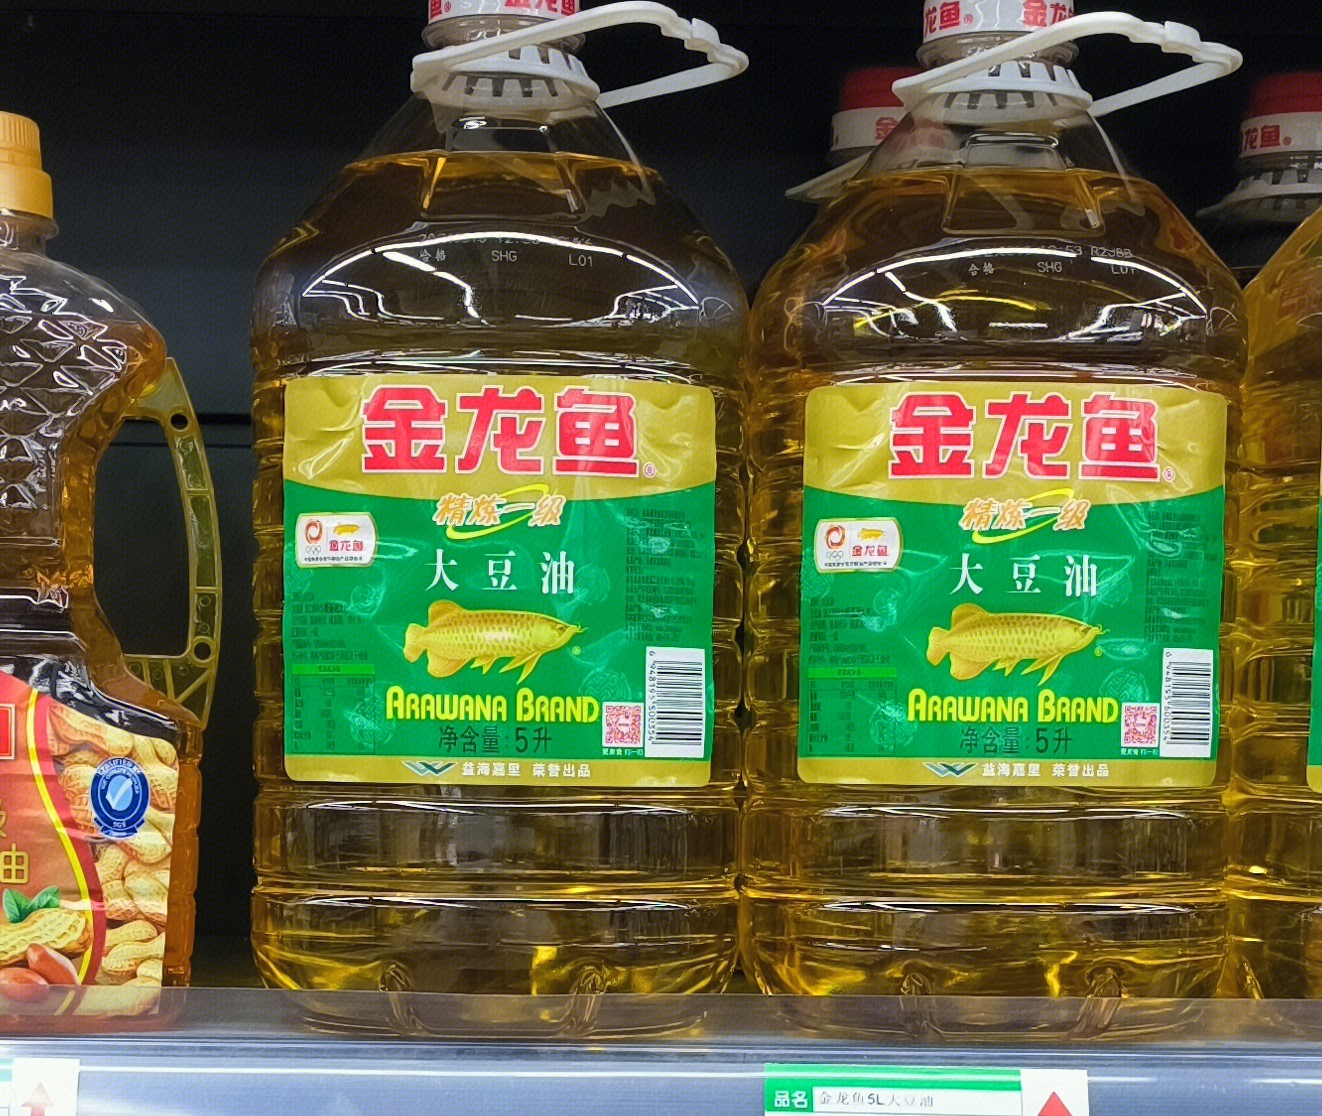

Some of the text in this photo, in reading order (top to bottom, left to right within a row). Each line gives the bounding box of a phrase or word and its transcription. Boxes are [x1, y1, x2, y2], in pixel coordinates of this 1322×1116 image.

[491, 249, 518, 263] SHG
[1036, 261, 1063, 273] SHG
[361, 384, 639, 477] 金龙鱼
[888, 391, 1161, 482] 金龙鱼
[432, 493, 568, 528] 精炼一级
[961, 498, 1092, 532] 精炼一级
[852, 545, 889, 556] 金龙鱼
[424, 549, 575, 594] 大豆油
[950, 553, 1098, 597] 大豆油
[386, 686, 600, 723] ARAWANA BRAND
[907, 688, 1119, 723] ARAWANA BRAND
[439, 725, 553, 754] 净含量:5升
[959, 726, 1072, 755] 净含量:5升
[461, 762, 591, 778] 益海嘉里 荣誉出品
[982, 762, 1110, 778] 益海嘉里 荣誉出品
[775, 1091, 808, 1109] 品名
